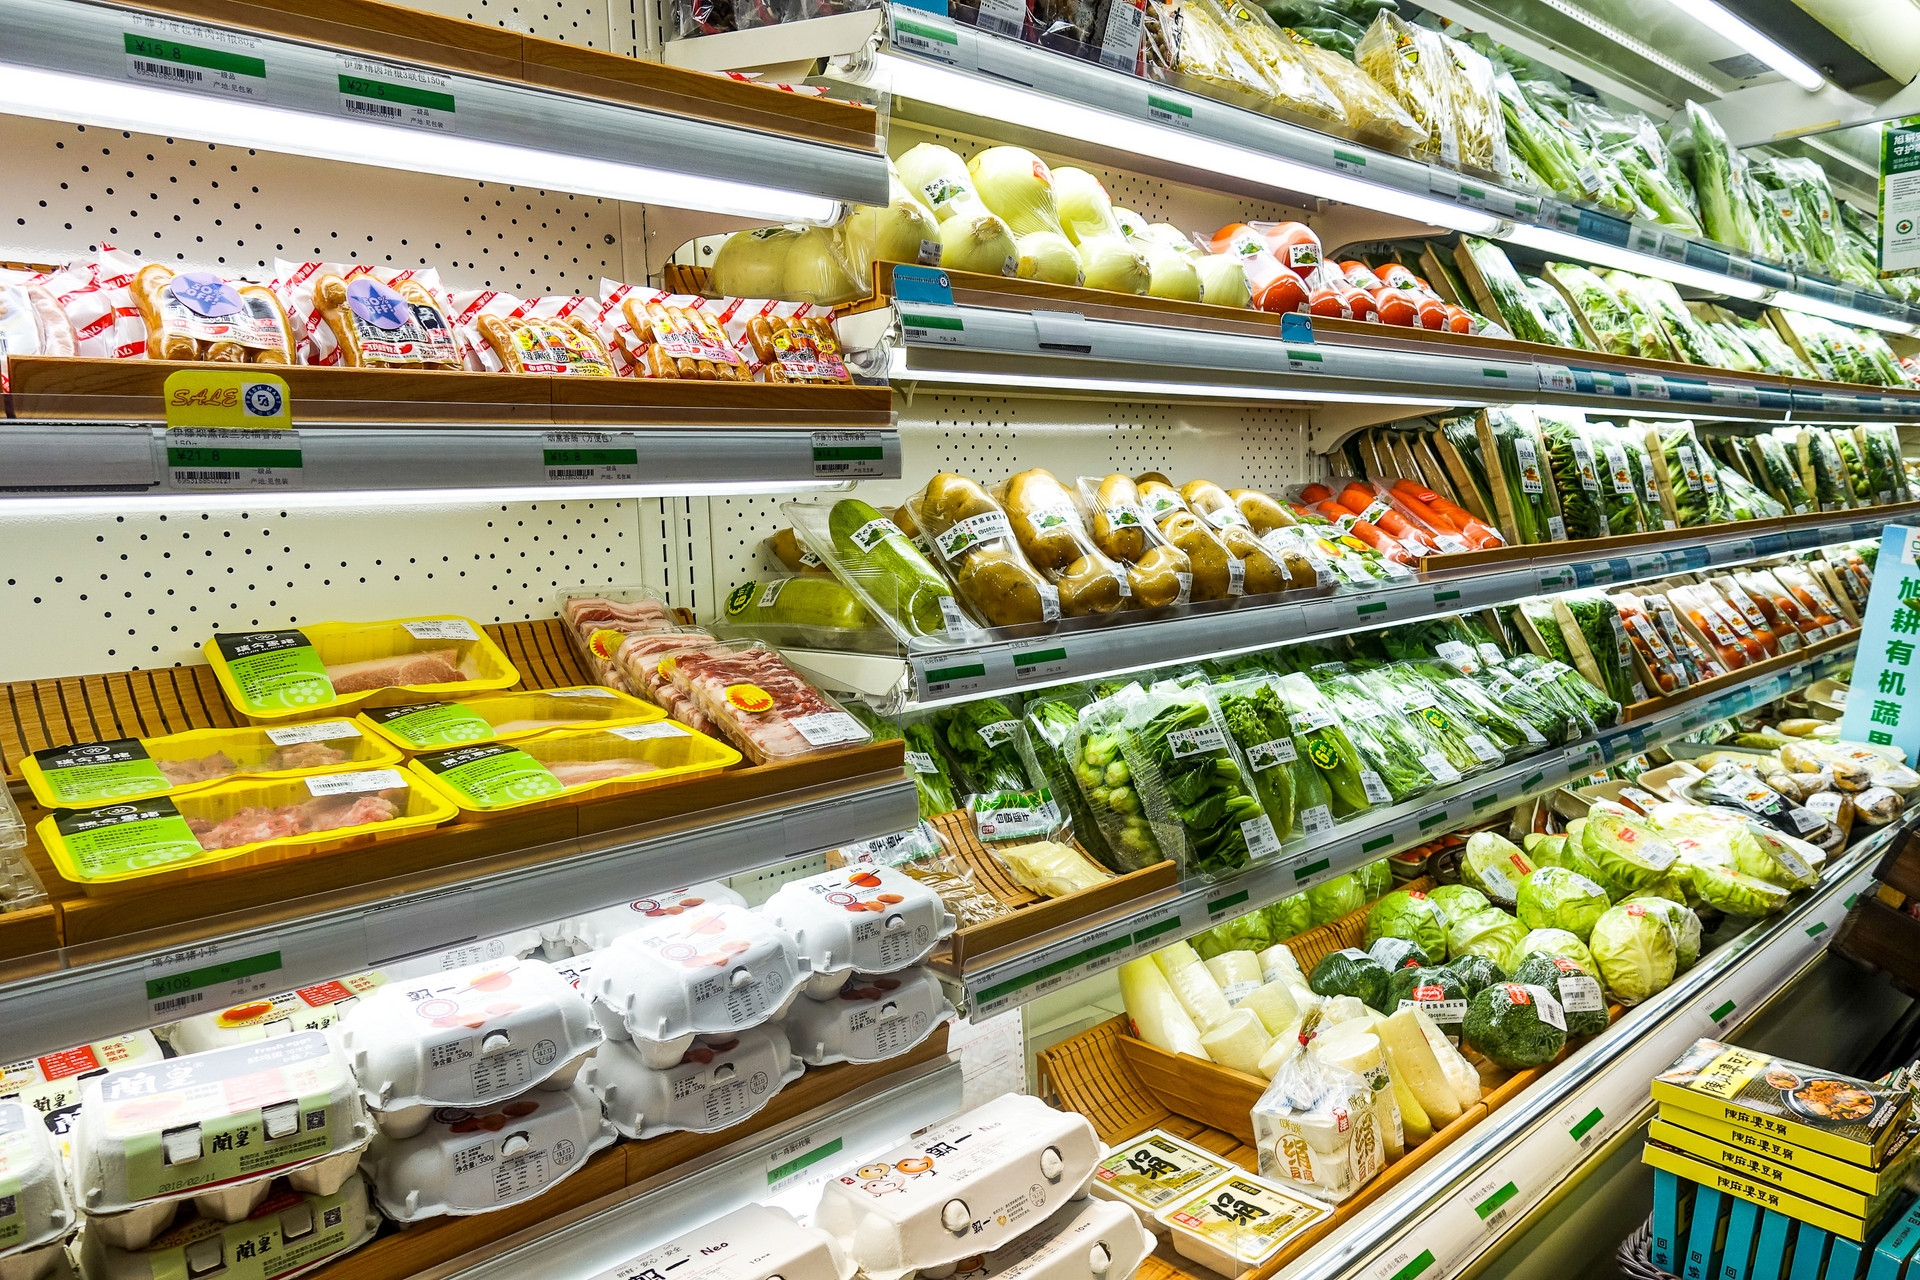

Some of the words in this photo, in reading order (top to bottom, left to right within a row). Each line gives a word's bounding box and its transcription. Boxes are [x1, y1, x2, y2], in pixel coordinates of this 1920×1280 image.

[171, 387, 239, 408] SALE
[153, 976, 192, 994] ¥108
[1724, 1107, 1788, 1137] 陳麻婆豆腐
[1731, 1129, 1794, 1162] 陳麻婆豆腐
[1721, 1150, 1783, 1182] 陳麻婆豆腐
[158, 1172, 217, 1194] 2018/02/11
[1717, 1175, 1780, 1207] 陳麻婆豆腐
[700, 1241, 729, 1257] Neo
